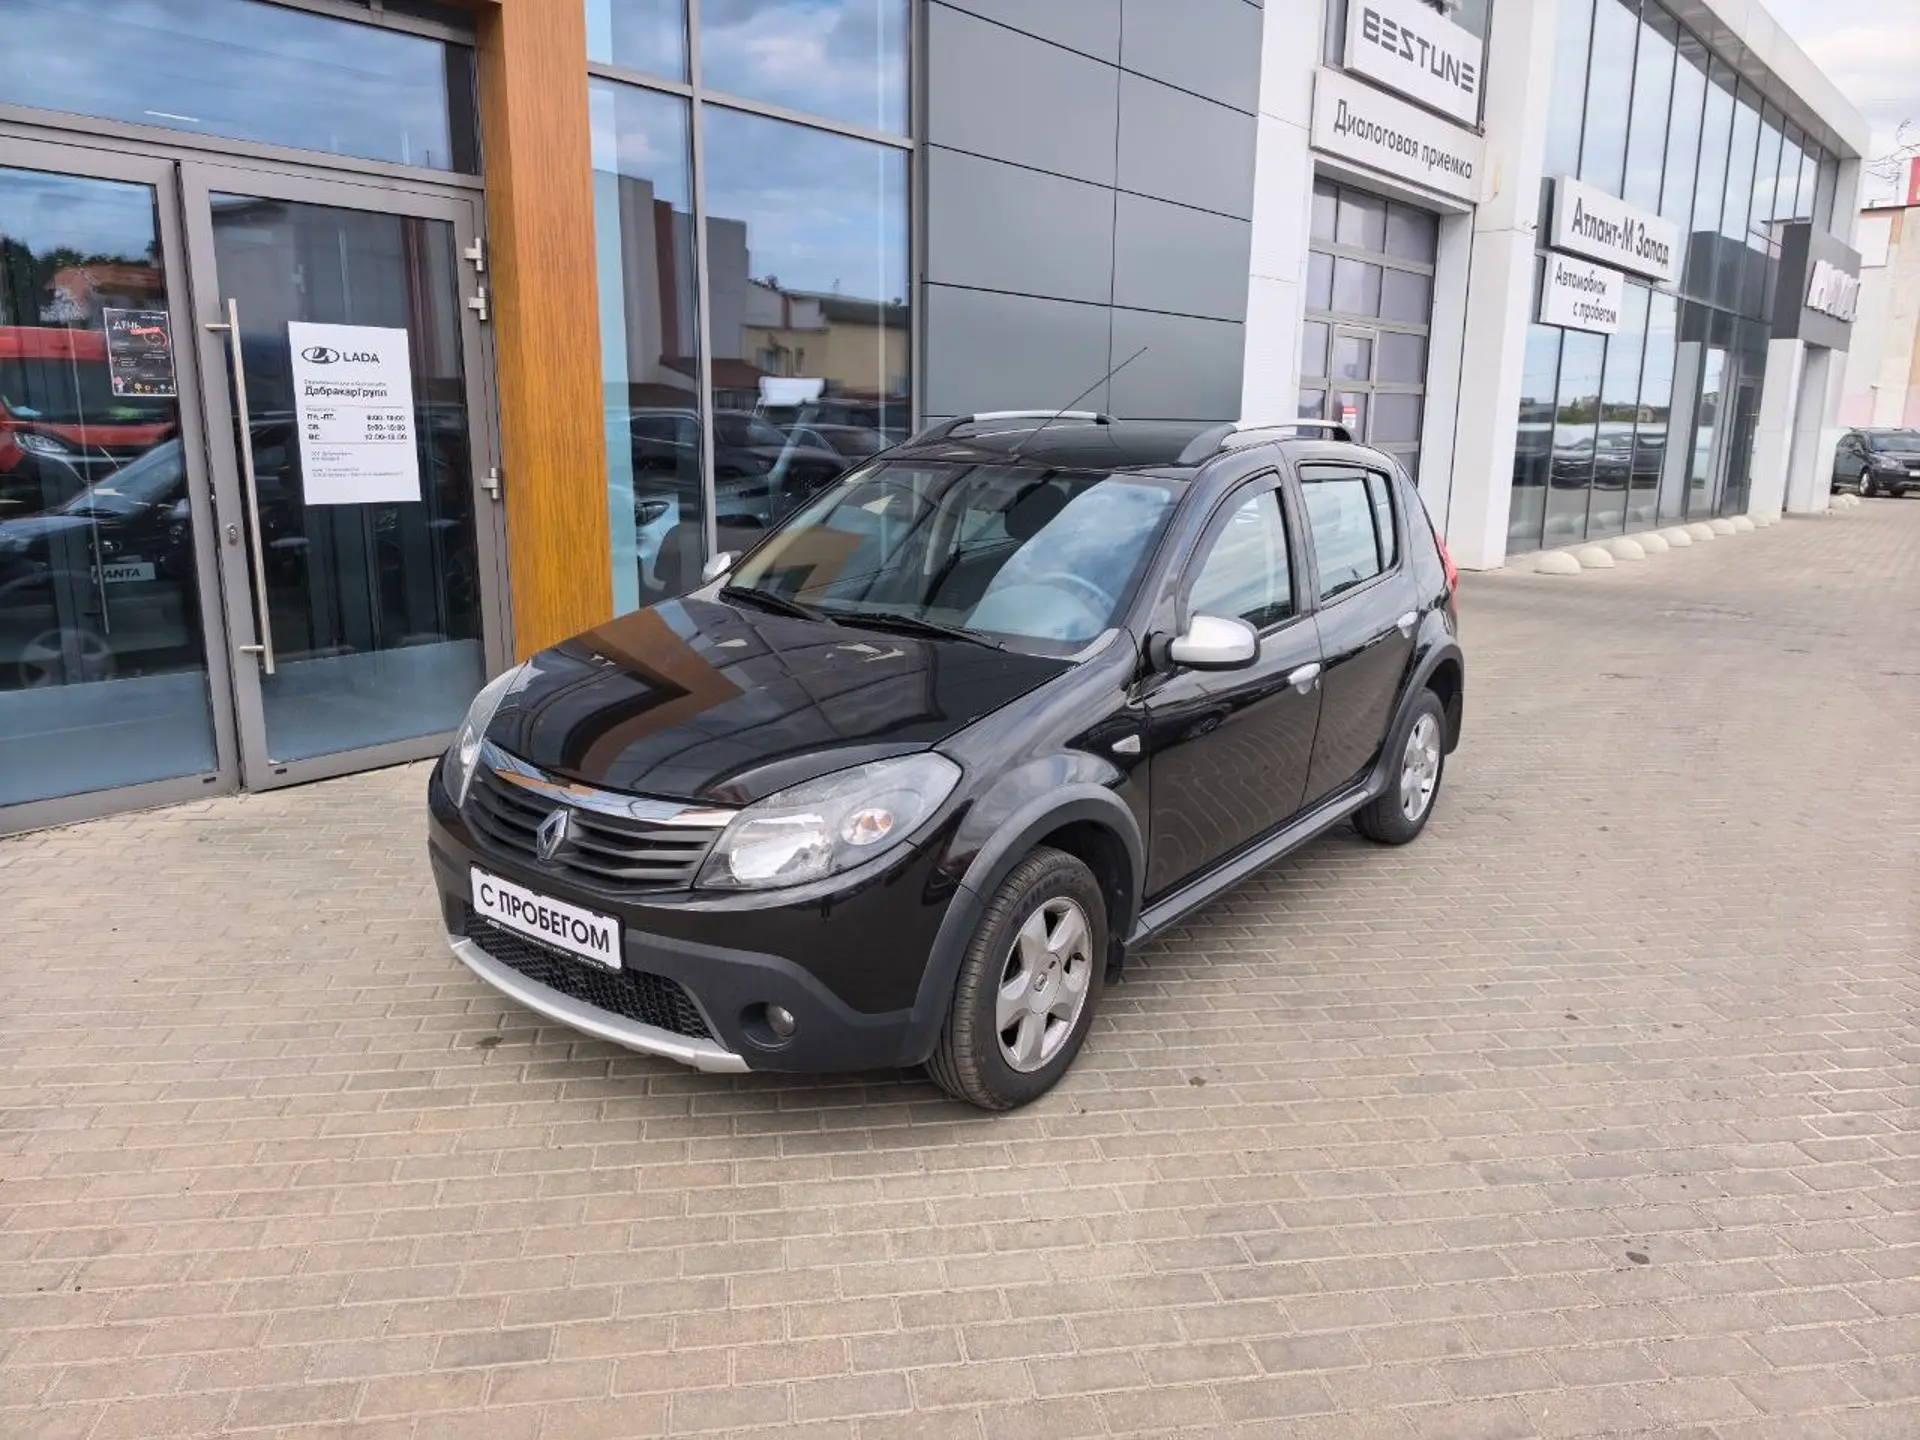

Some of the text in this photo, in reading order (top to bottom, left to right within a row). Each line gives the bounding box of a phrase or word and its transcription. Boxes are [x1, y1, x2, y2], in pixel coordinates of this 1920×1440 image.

[1362, 6, 1476, 94] BESTUNE
[1333, 98, 1473, 180] Диалоговая приемка
[1571, 197, 1669, 269] Атлант-М Запад
[1555, 261, 1607, 296] Автомобили
[1578, 298, 1617, 324] пробегом
[342, 351, 380, 364] LADA
[304, 386, 388, 398] ДабракарГрупп
[480, 883, 494, 907] С
[499, 890, 610, 953] ПРОБЕГОМ
